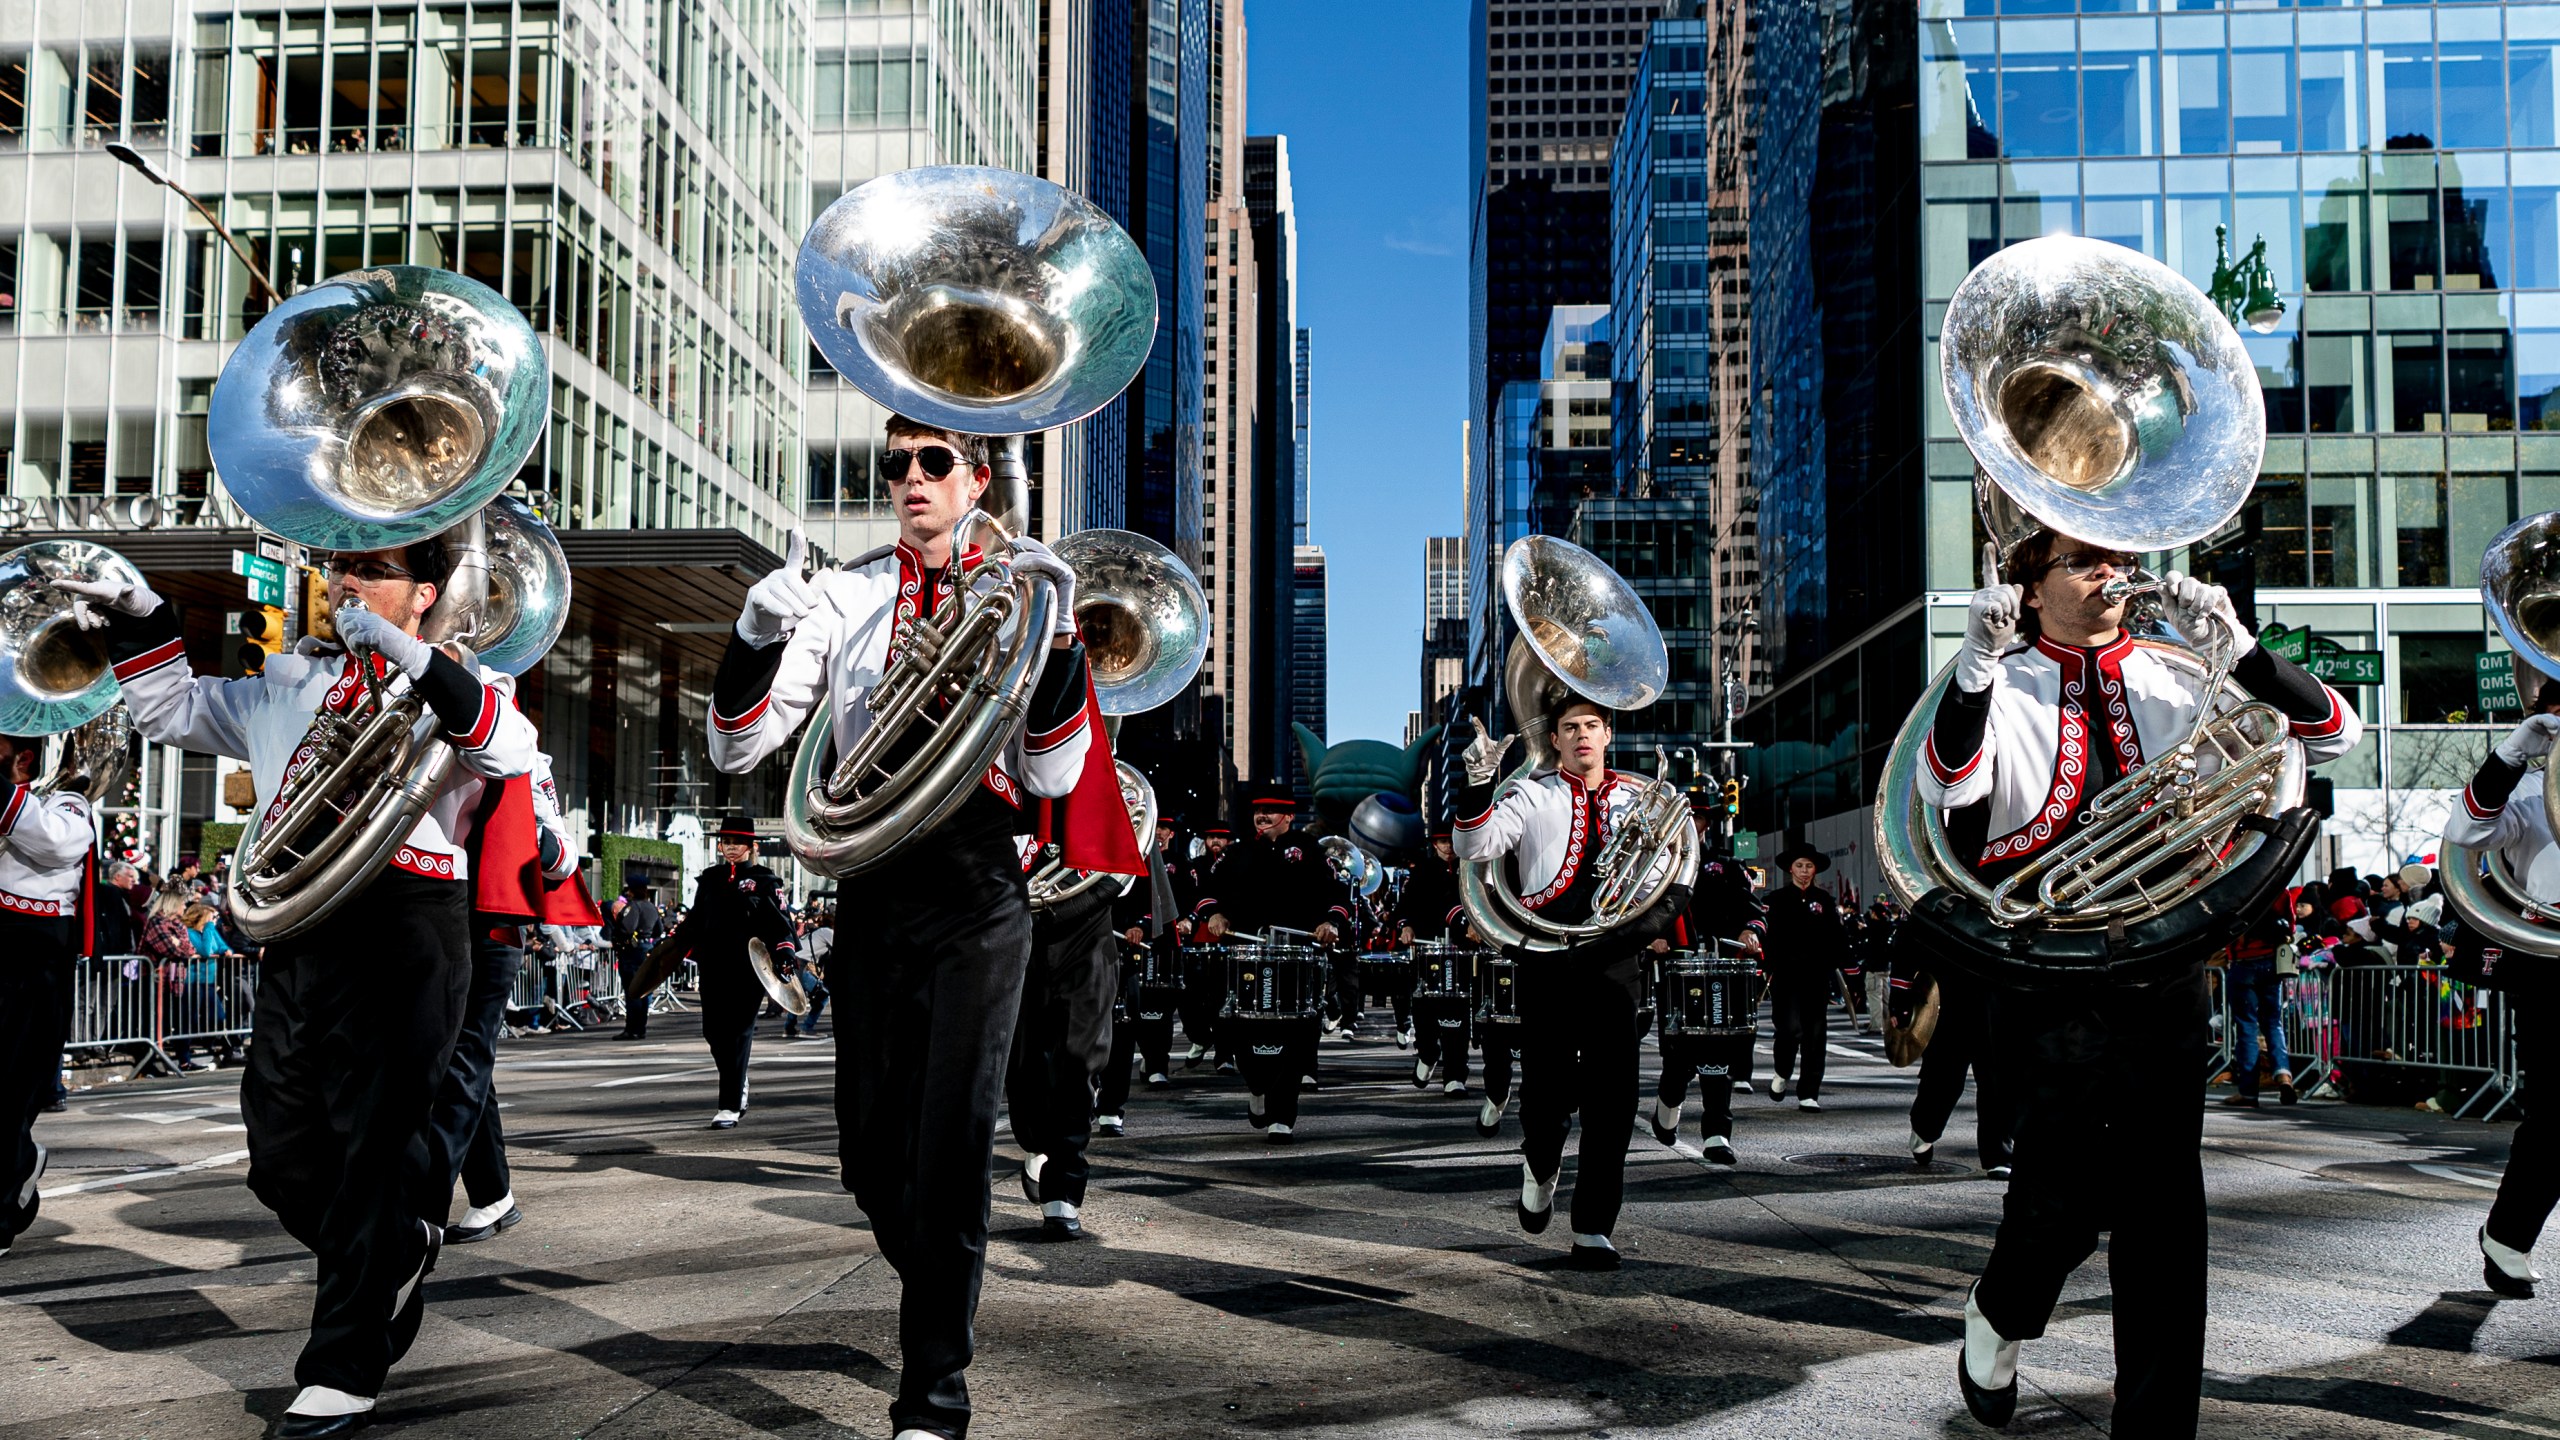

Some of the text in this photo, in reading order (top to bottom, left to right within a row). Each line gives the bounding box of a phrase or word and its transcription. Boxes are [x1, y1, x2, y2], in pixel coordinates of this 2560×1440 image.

[0, 493, 119, 530] BANK
[129, 493, 187, 530] OF
[265, 545, 281, 559] ONE
[249, 565, 278, 582] Americas
[263, 586, 269, 600] 6
[2314, 659, 2350, 677] 42nd
[2355, 660, 2374, 677] St
[2480, 673, 2515, 690] QM5
[2481, 692, 2517, 710] QM6
[1263, 977, 1272, 1009] YAMAHA
[1712, 992, 1723, 1025] YAMAHA
